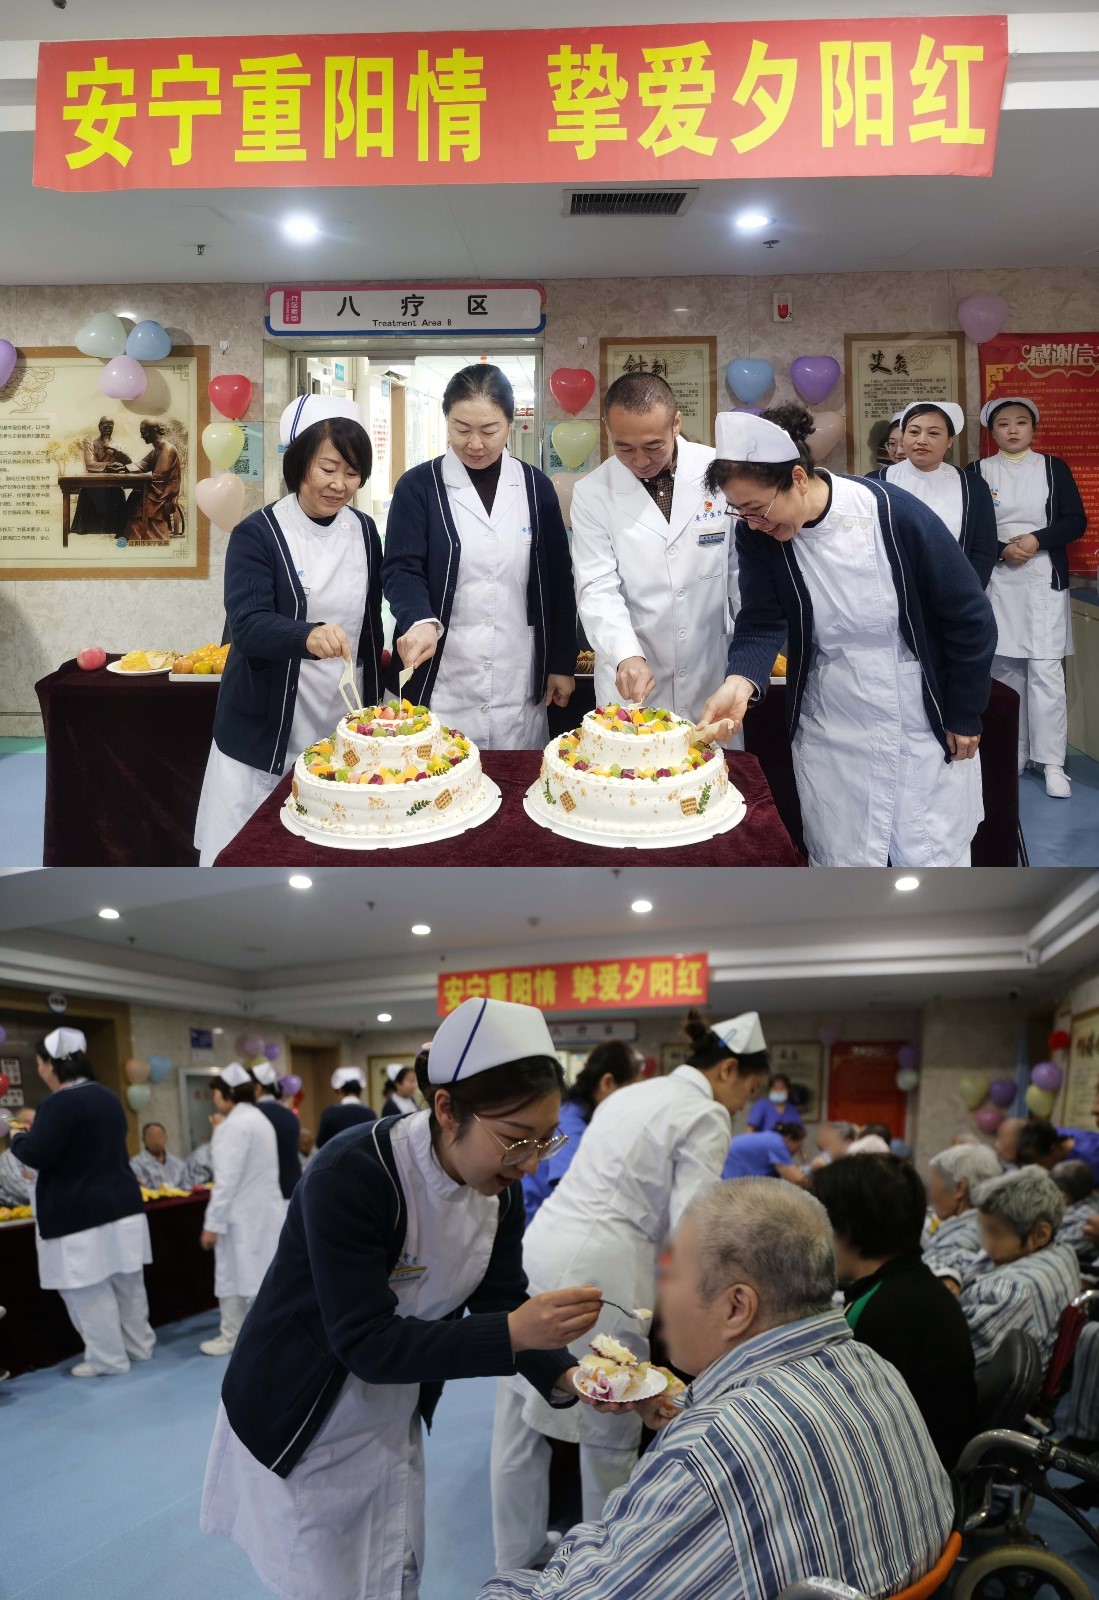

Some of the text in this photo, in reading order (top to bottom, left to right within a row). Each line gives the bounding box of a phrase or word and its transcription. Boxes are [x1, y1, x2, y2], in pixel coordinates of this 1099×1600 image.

[62, 34, 985, 168] 安宁重阳情 挚爱夕阳红
[337, 293, 488, 317] 八疗区
[372, 319, 417, 327] Treatment
[422, 319, 442, 327] Area
[1028, 343, 1094, 366] 感谢信
[443, 960, 703, 1012] 安宁重阳情 挚爱夕阳红
